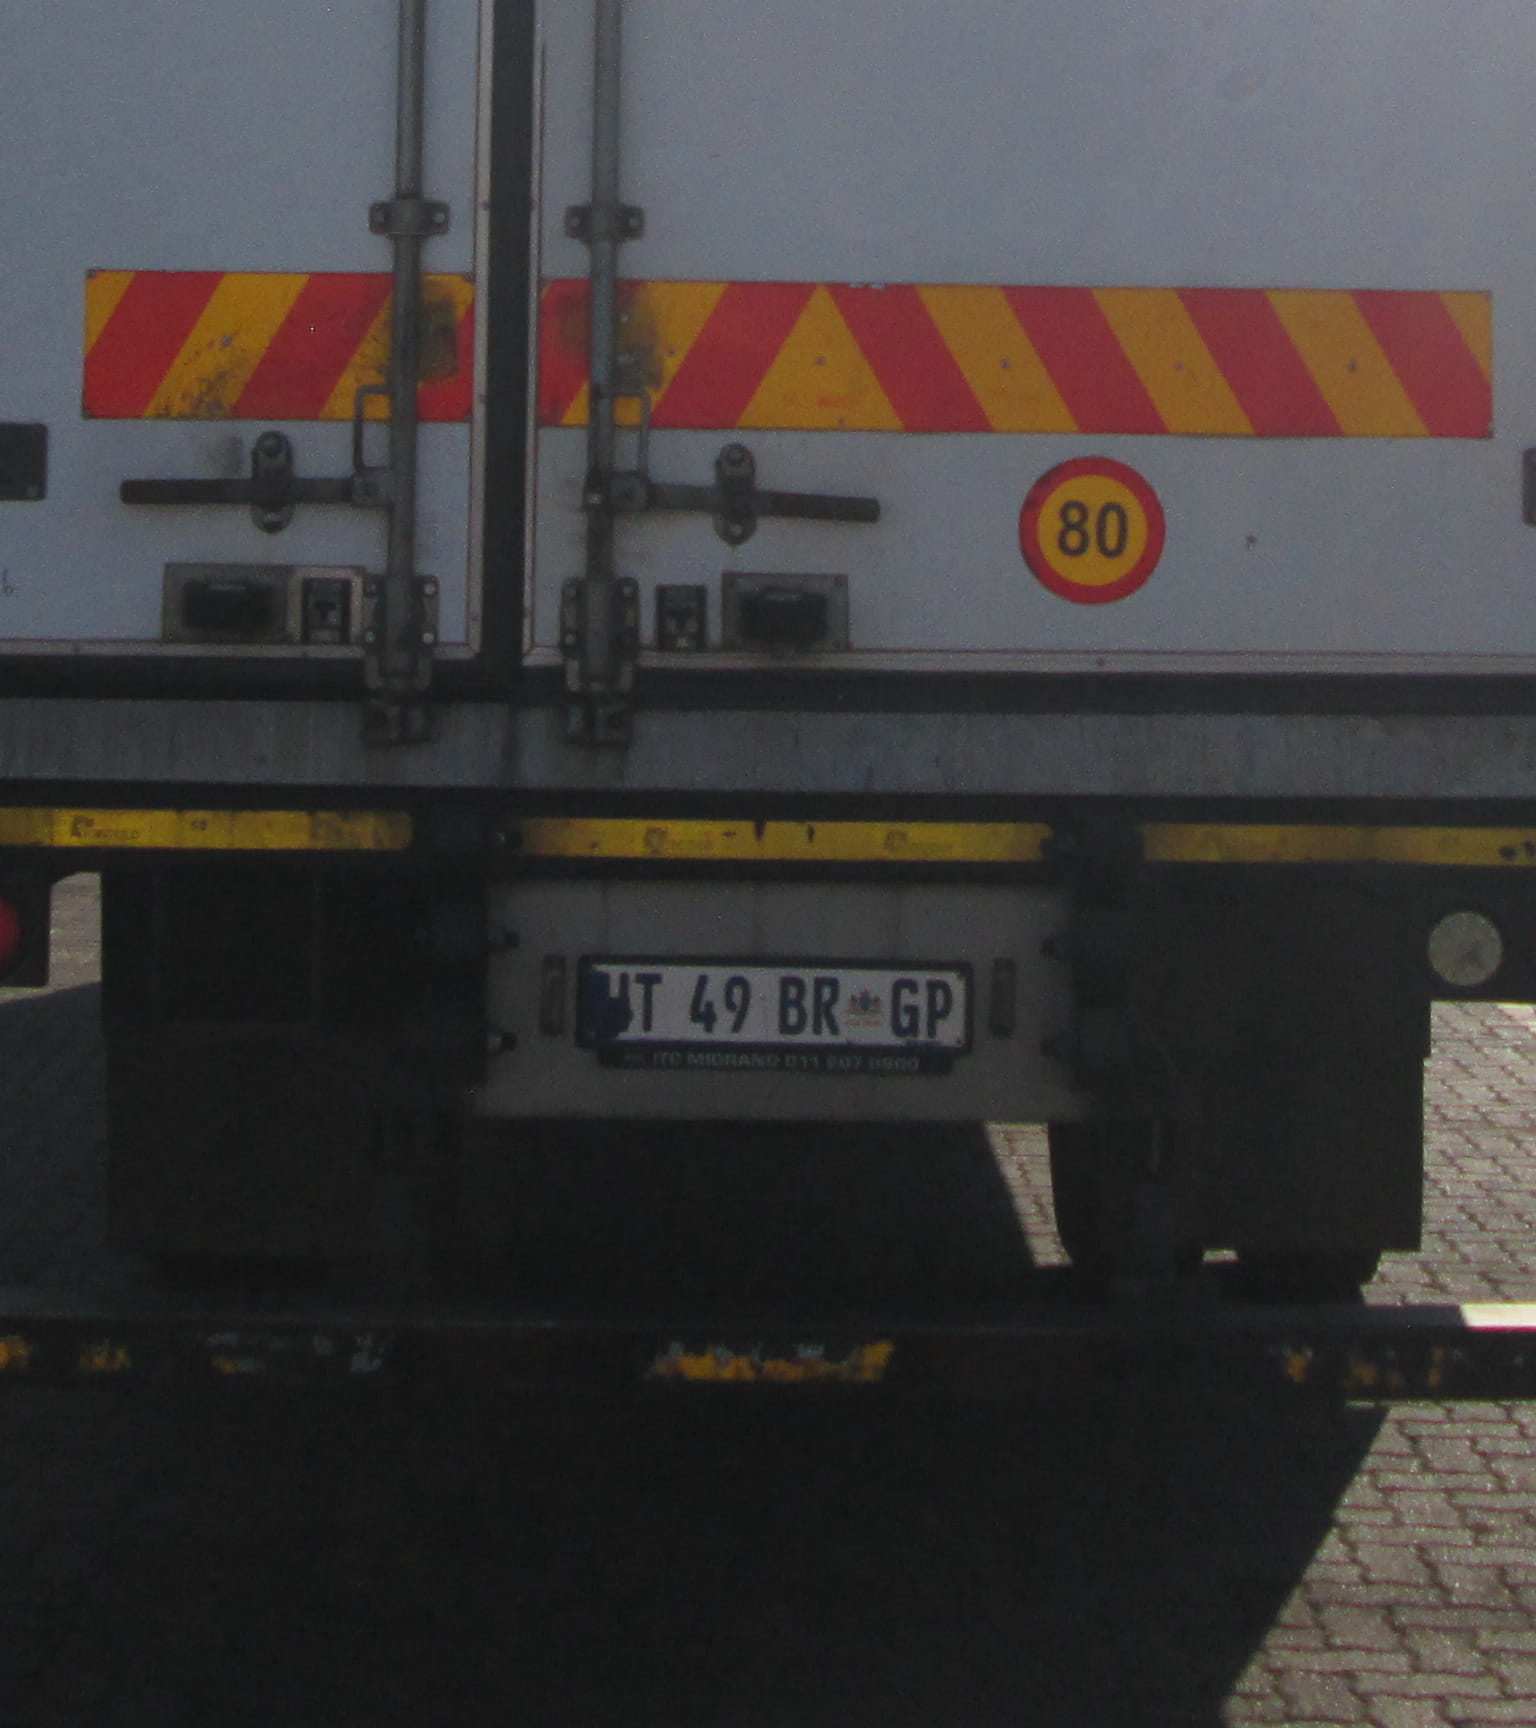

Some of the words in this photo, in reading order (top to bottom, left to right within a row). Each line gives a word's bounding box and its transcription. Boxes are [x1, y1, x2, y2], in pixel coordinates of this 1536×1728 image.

[1057, 499, 1129, 560] 80
[689, 974, 752, 1034] 49
[779, 975, 840, 1036] BR
[890, 977, 954, 1039] GP
[686, 1052, 781, 1068] MIDRAND
